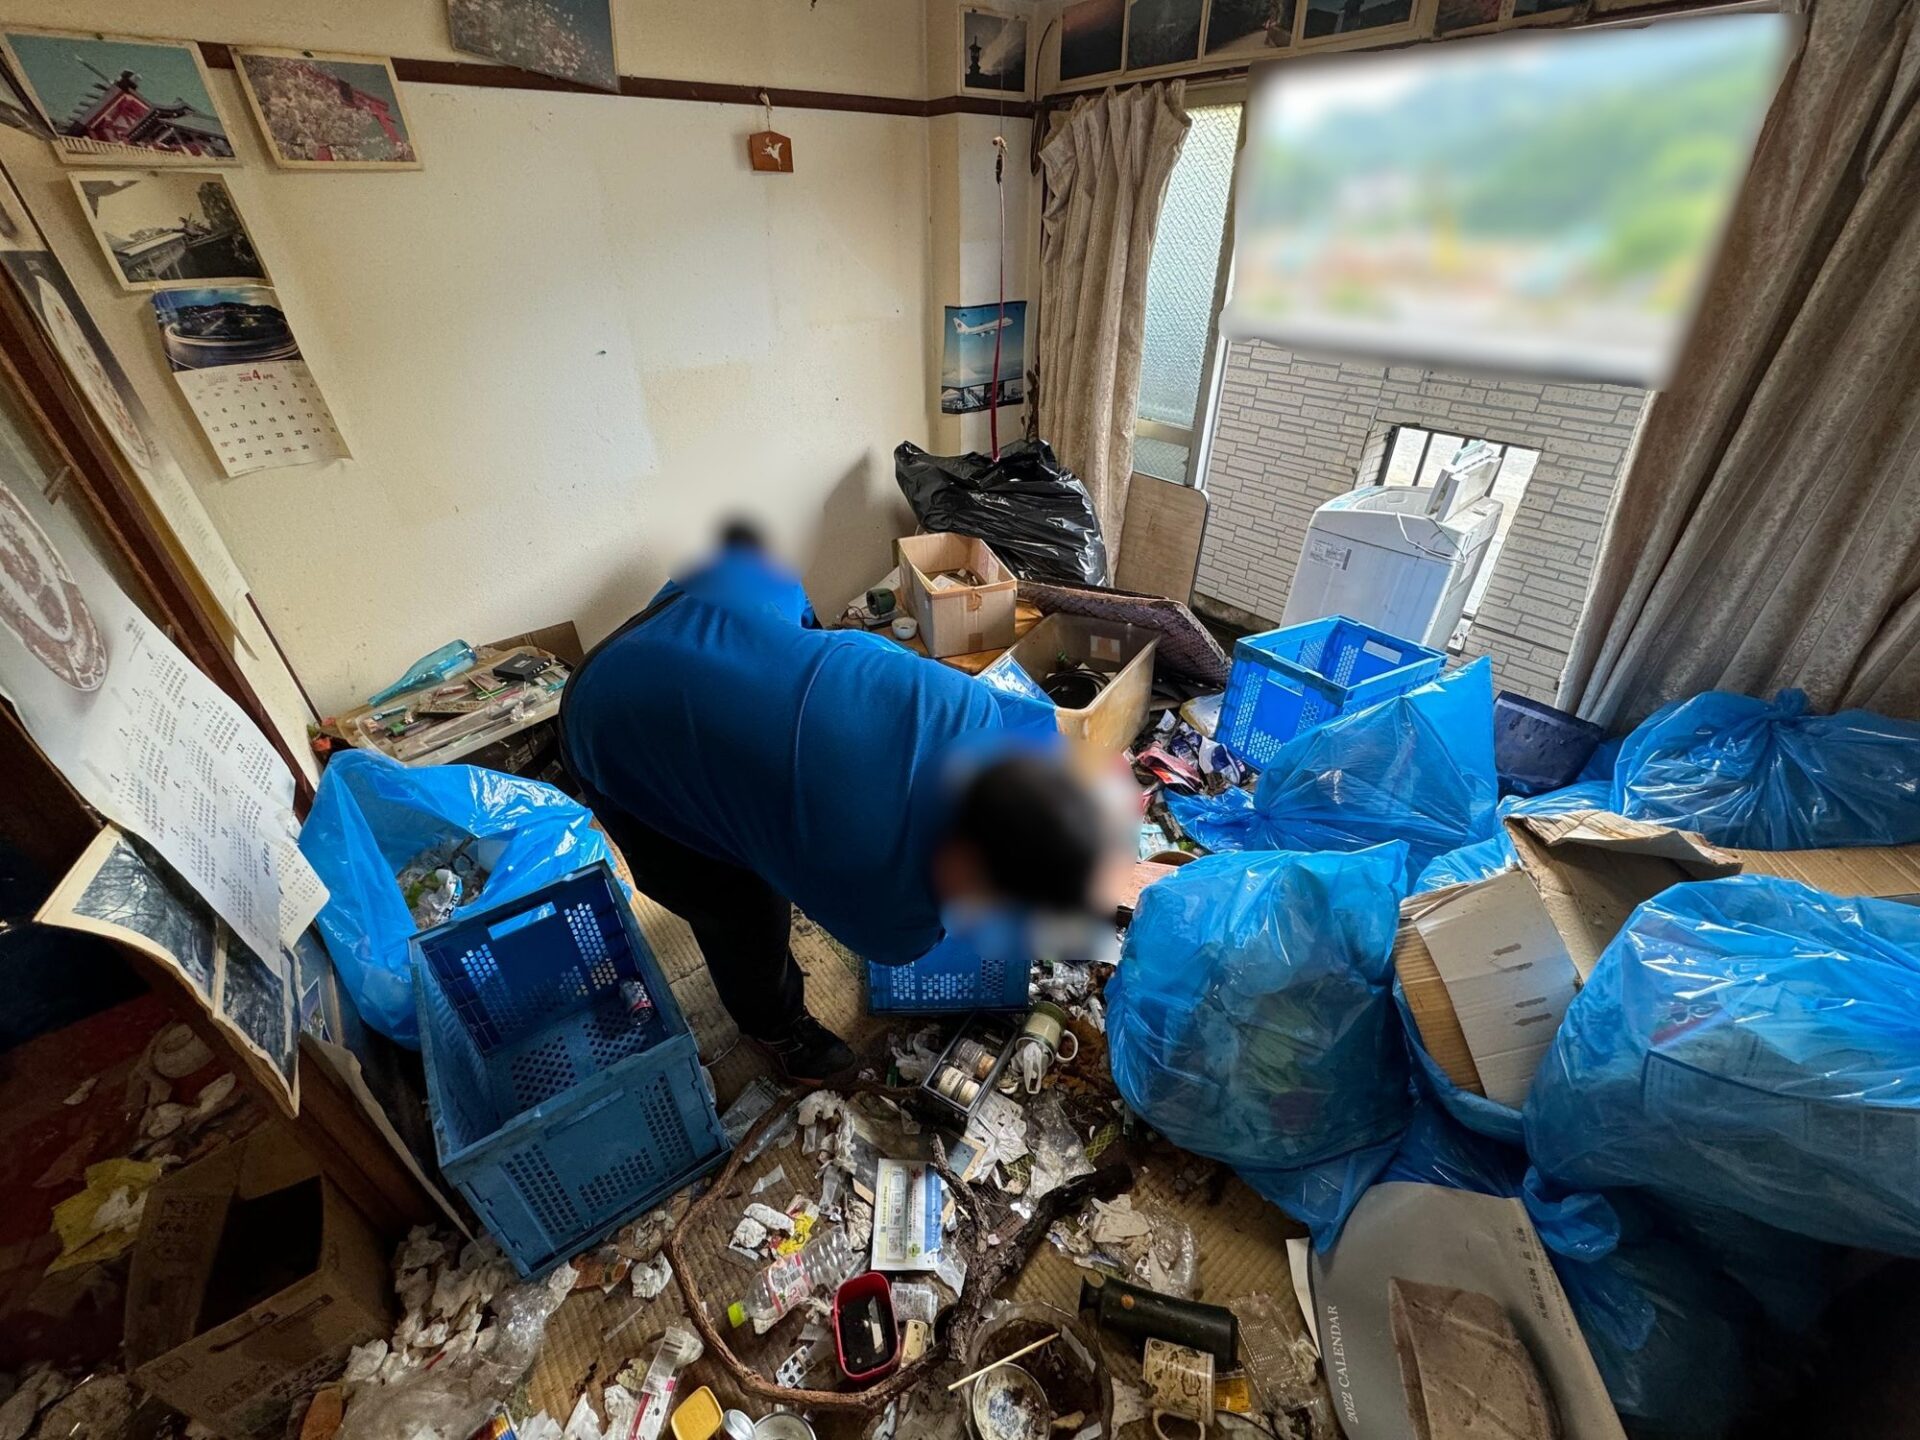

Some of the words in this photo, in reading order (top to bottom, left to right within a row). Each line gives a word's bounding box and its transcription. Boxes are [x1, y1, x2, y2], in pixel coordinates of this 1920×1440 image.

[252, 369, 260, 380] 4
[236, 743, 245, 753] 12
[221, 785, 228, 796] 11
[1327, 1305, 1350, 1388] CALENDAR
[1342, 1391, 1359, 1424] 2022
